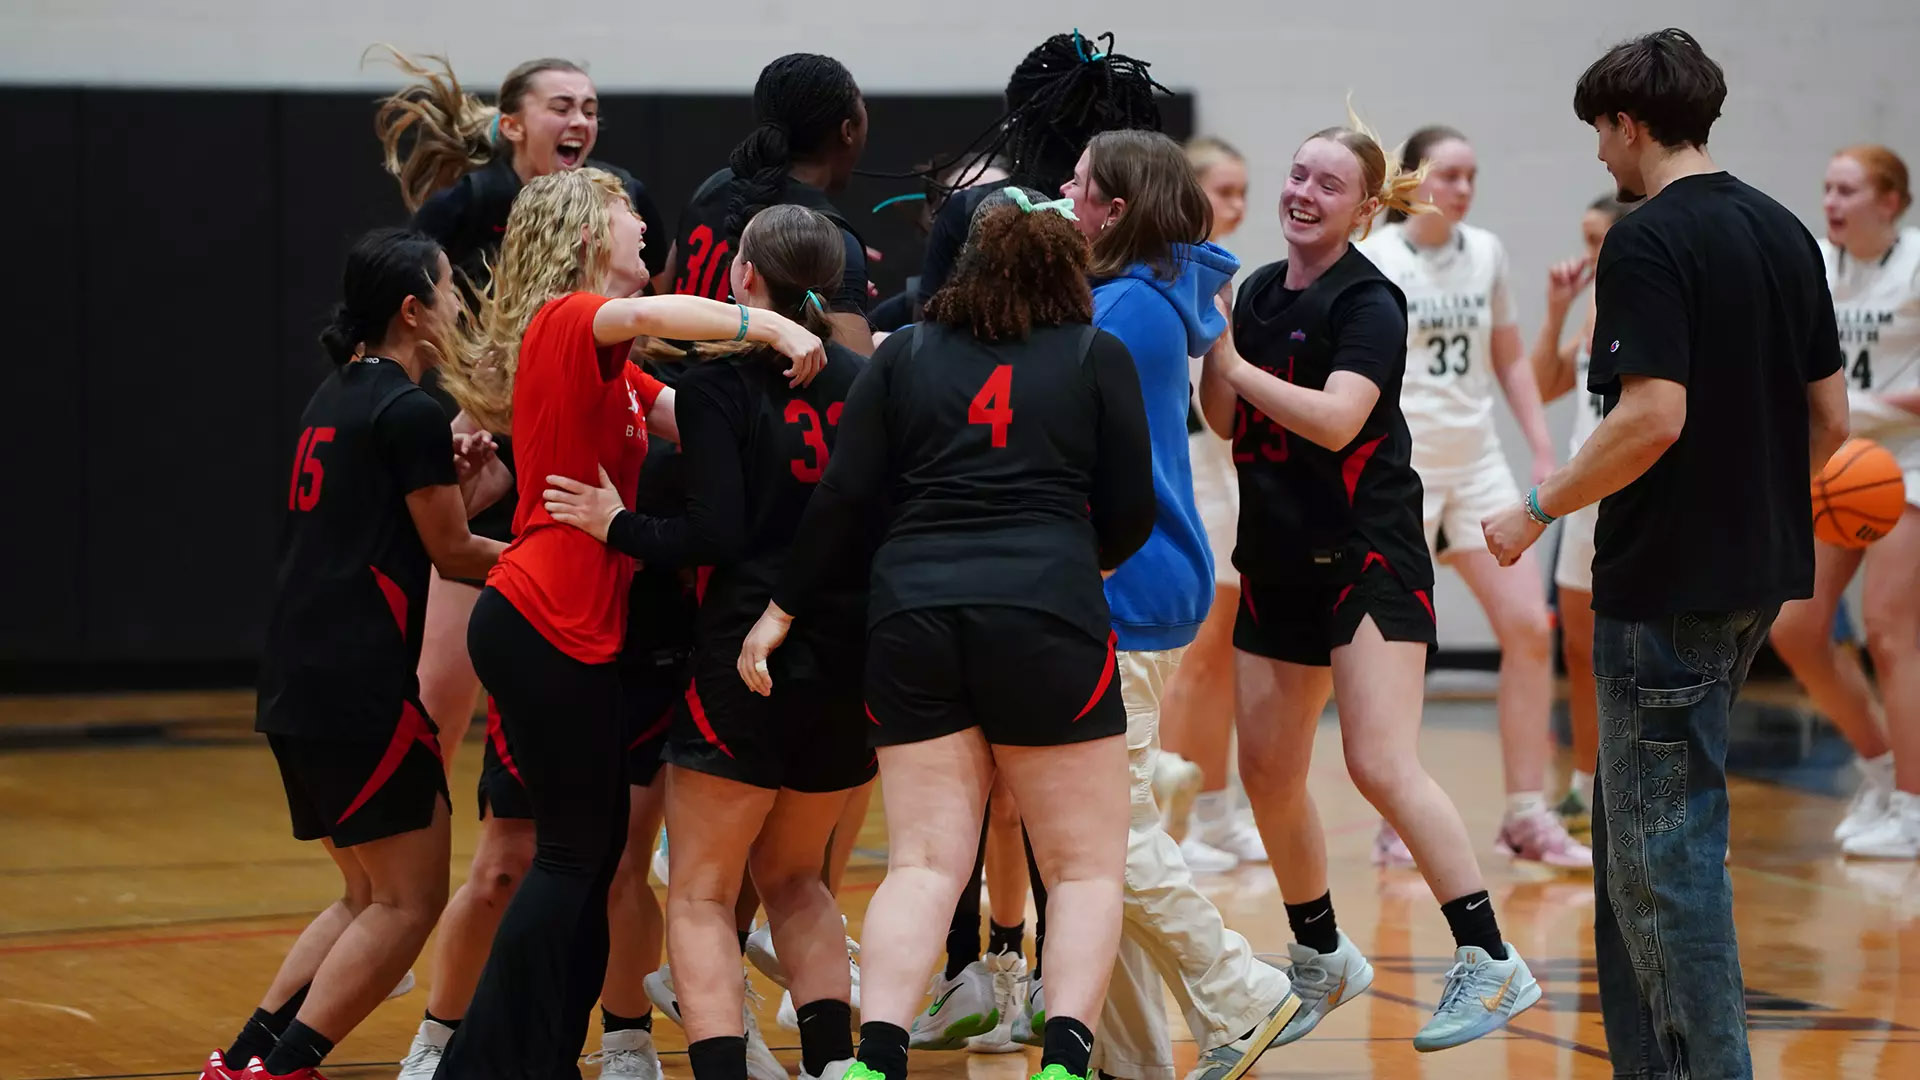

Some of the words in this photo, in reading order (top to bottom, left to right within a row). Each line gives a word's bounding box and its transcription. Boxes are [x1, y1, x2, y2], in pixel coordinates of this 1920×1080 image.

[1418, 315, 1478, 330] SMITH
[1427, 334, 1469, 376] 33
[784, 399, 845, 483] 3
[968, 364, 1014, 449] 4
[288, 426, 336, 512] 15
